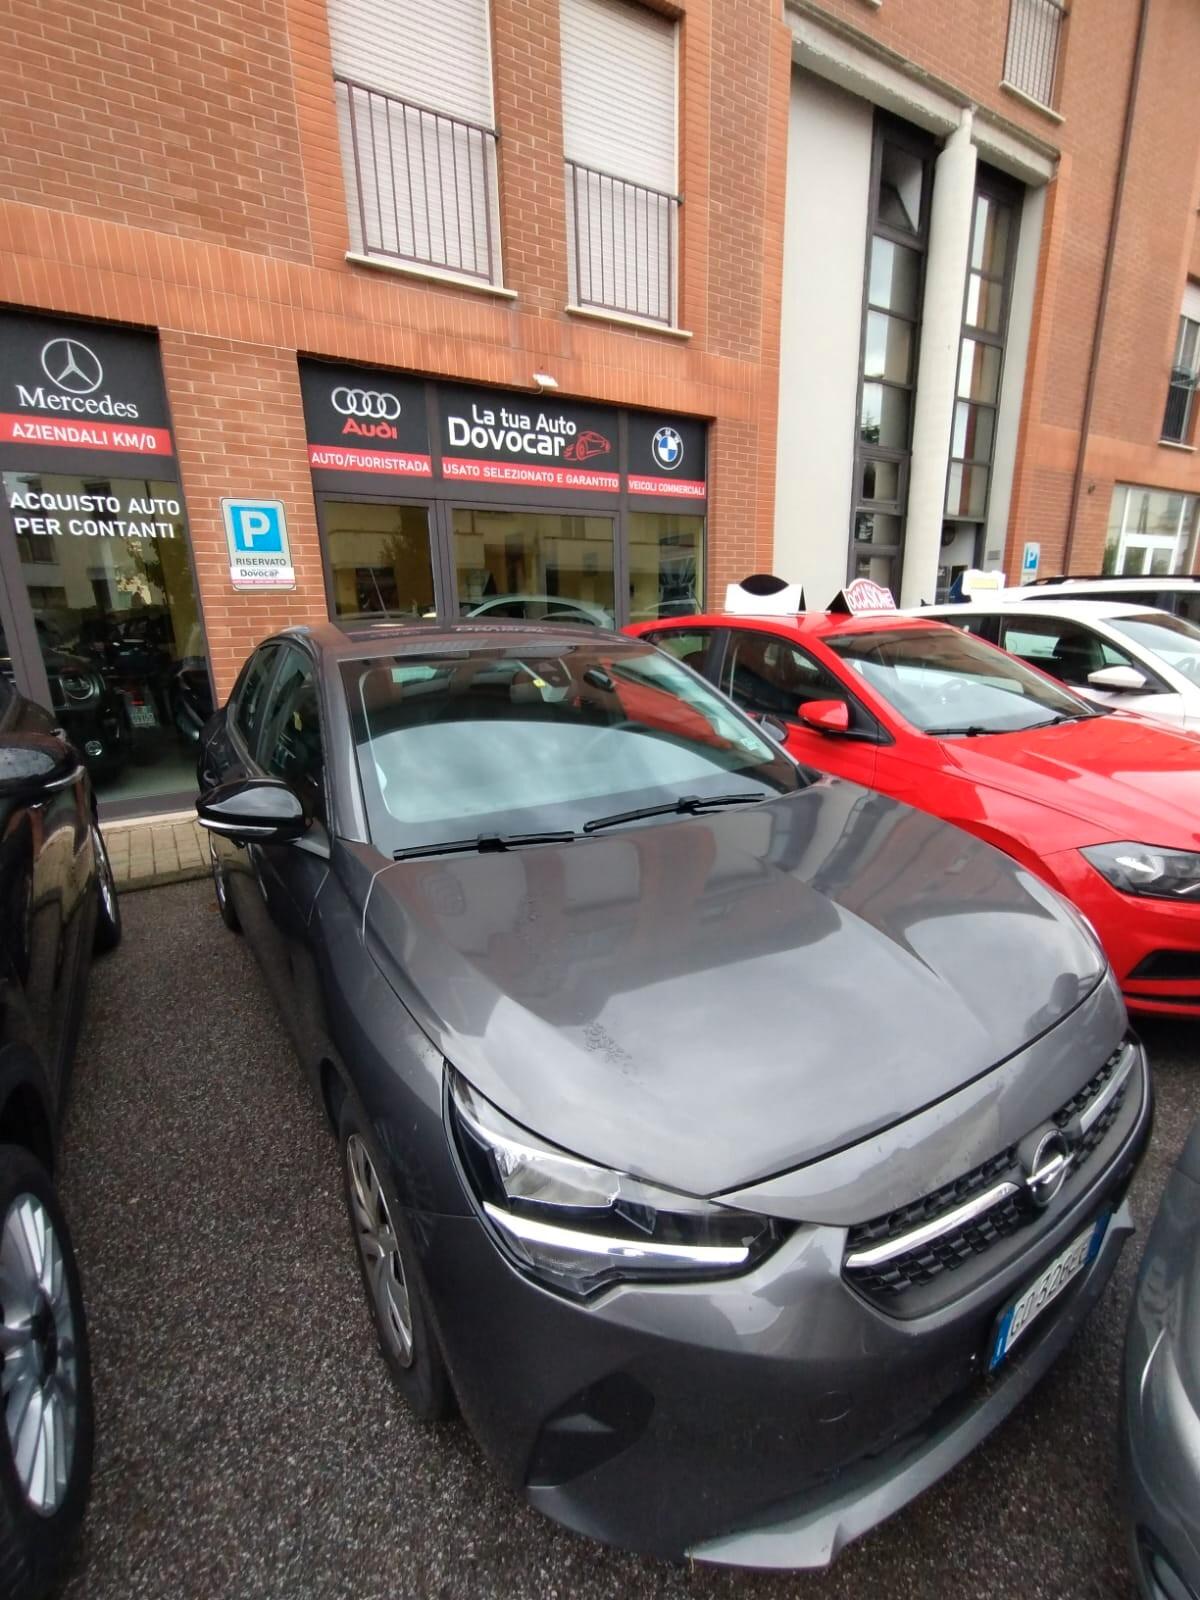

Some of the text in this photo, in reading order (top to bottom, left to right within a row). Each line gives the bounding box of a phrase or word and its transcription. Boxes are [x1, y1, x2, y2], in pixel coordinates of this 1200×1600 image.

[16, 385, 139, 419] Mercedes
[342, 417, 398, 440] Audi
[472, 403, 577, 436] La tua Auto
[12, 422, 156, 450] AZIENDALI KM/0
[448, 416, 566, 457] Dovocar
[311, 453, 431, 473] AUTO/FUORISTRADA
[443, 463, 618, 488] USATO SELEZIONATO E GARANTITO
[628, 480, 704, 496] VEICOLI COMMERCIALI
[10, 492, 180, 516] ACQUISTO AUTO
[15, 517, 176, 539] PER CONTANTI
[240, 510, 271, 548] P
[236, 558, 287, 566] RISERVATO
[240, 569, 279, 577] Dovocar
